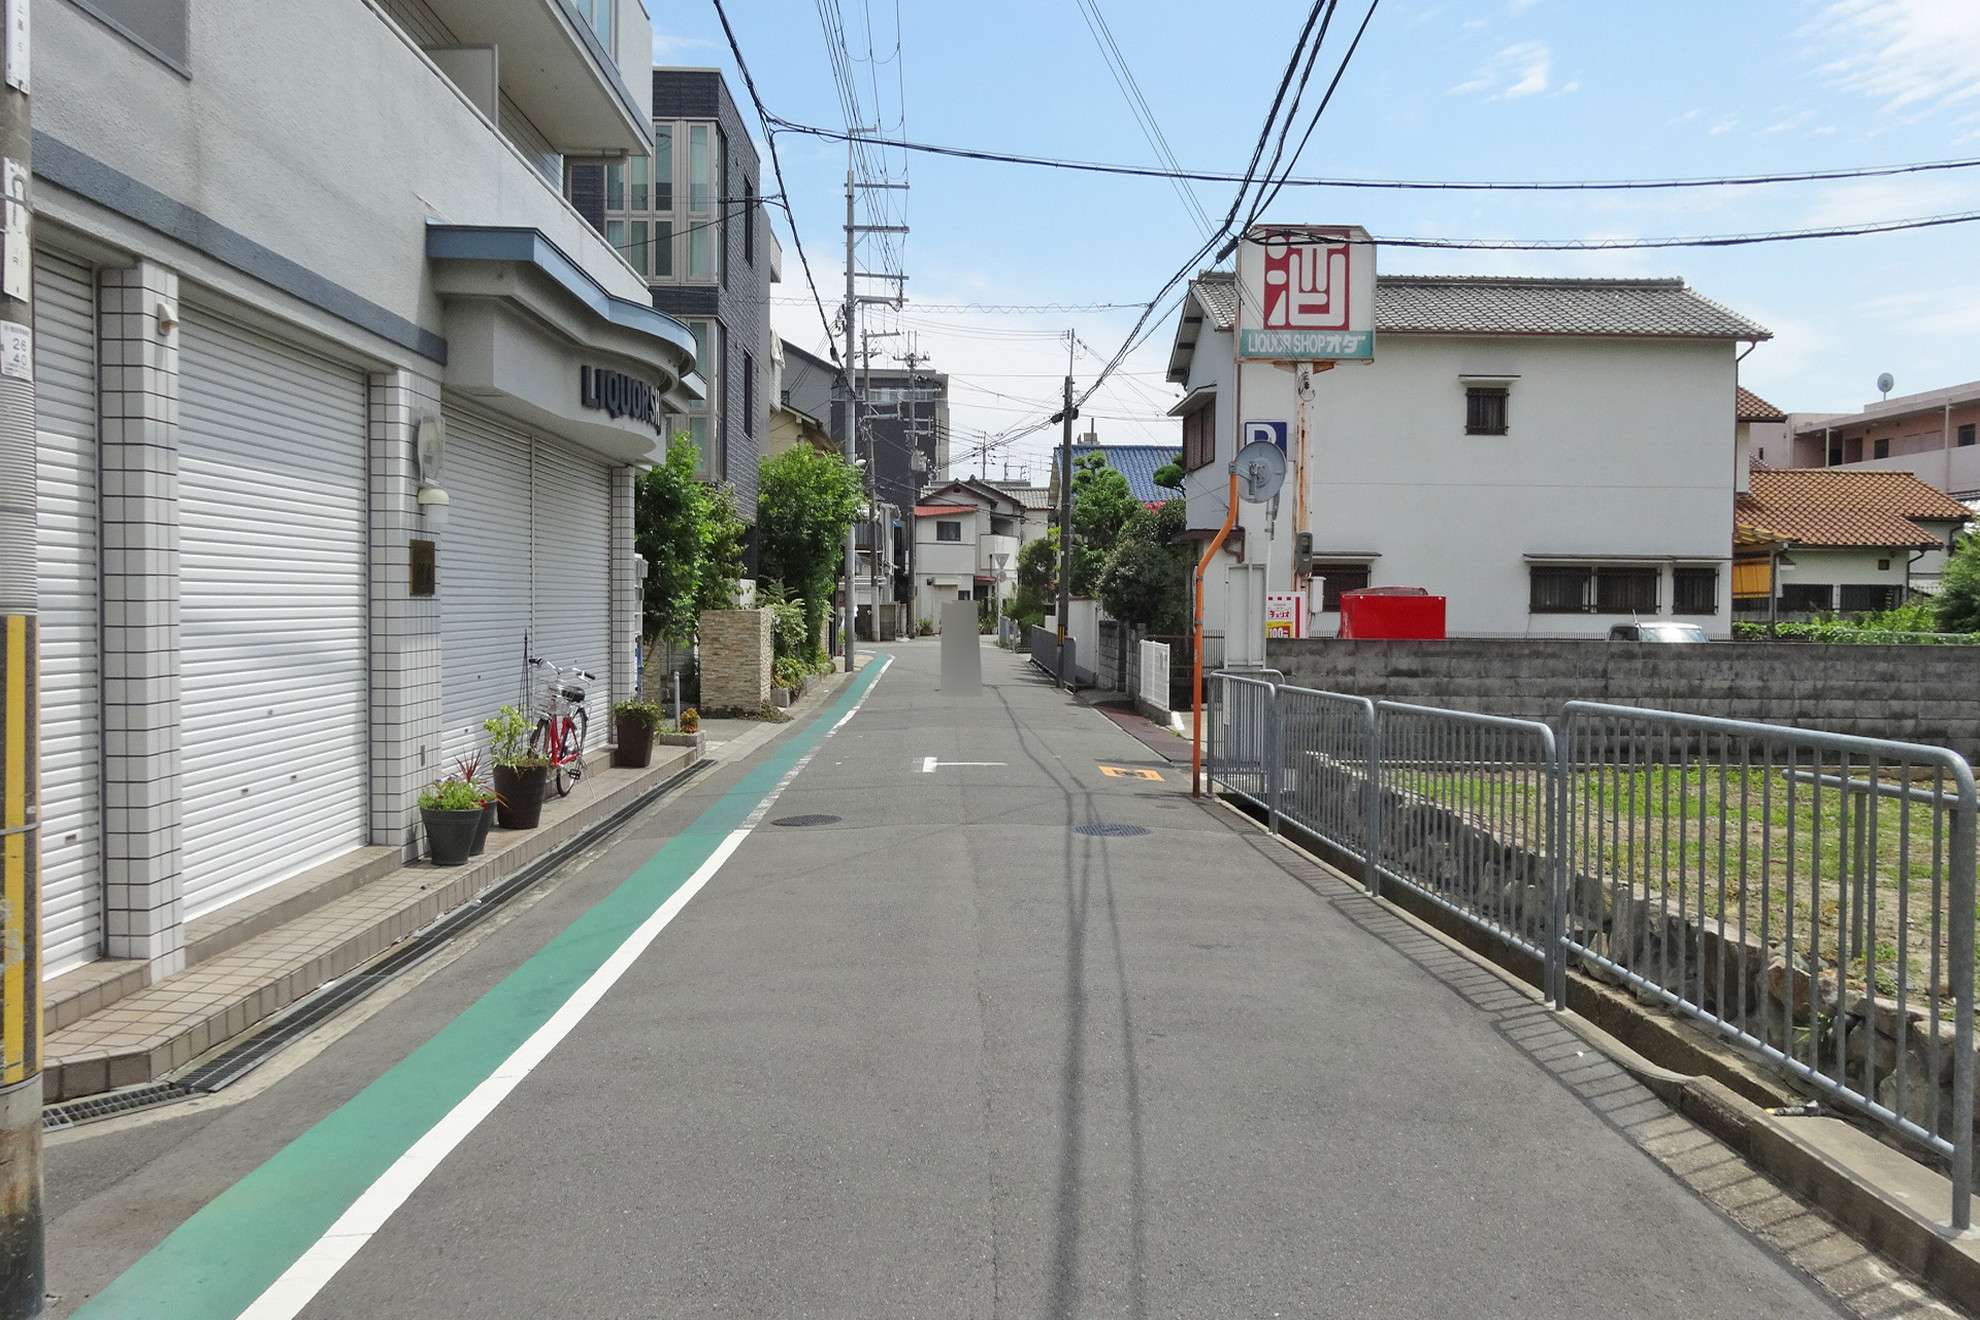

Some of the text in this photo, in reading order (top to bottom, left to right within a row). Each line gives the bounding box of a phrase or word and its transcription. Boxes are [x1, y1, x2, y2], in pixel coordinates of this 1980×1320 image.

[1266, 235, 1347, 327] 酒
[1248, 333, 1366, 353] LIQUOR SHOP オダ
[1246, 423, 1277, 446] P
